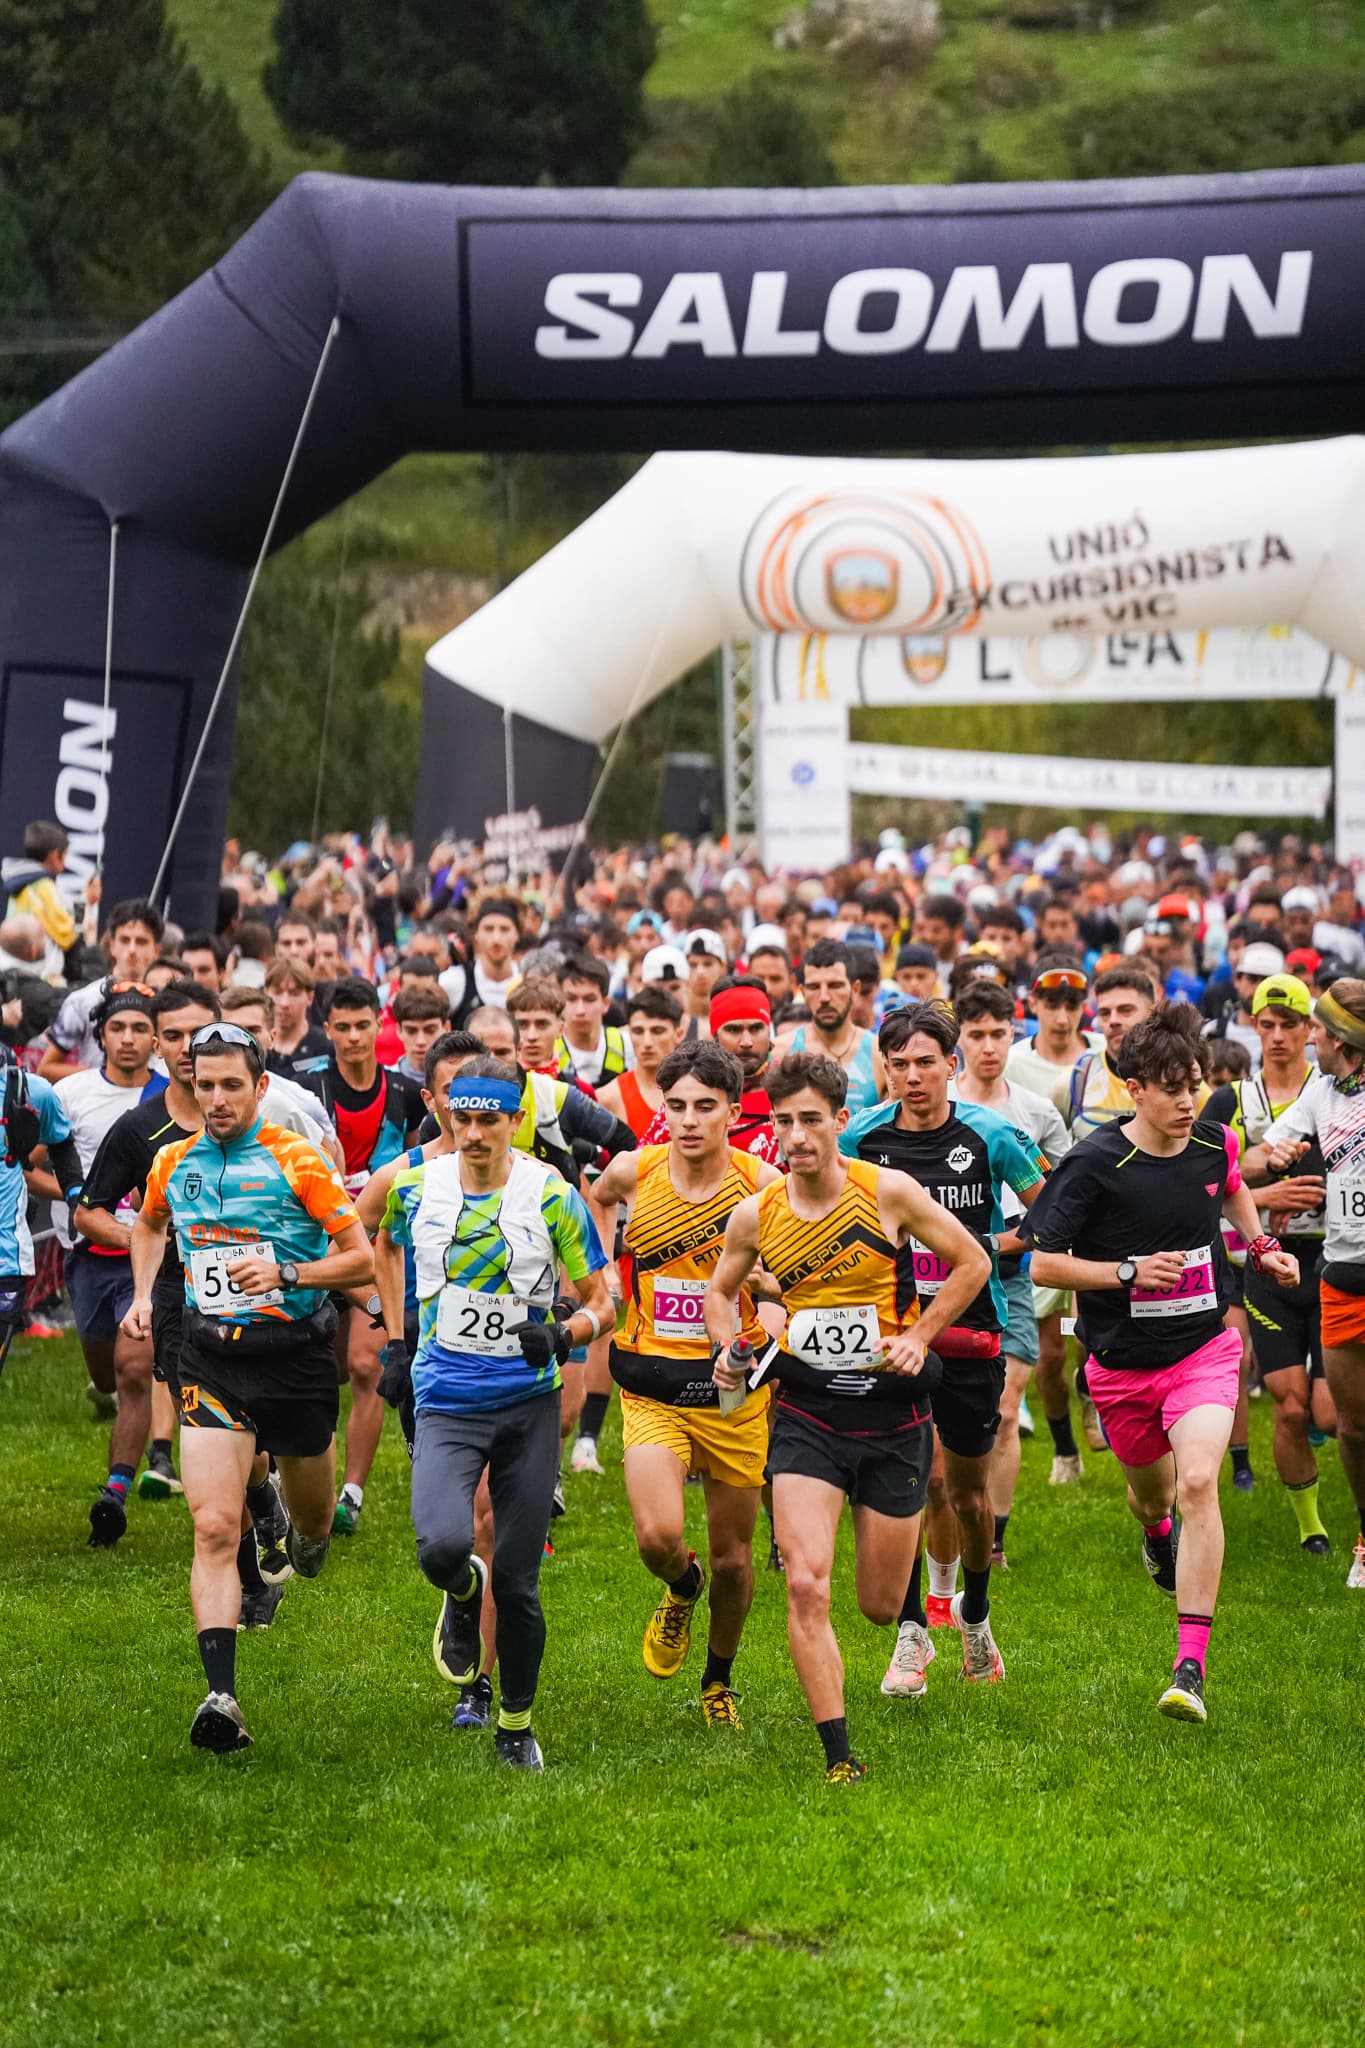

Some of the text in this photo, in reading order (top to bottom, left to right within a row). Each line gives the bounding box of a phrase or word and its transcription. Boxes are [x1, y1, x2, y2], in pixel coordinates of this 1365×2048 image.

[535, 250, 1314, 360] SALOMON
[1049, 510, 1149, 563] UNIÓ
[947, 531, 1295, 614] EXCURSIONISTA
[1103, 592, 1177, 623] VIC
[937, 1182, 985, 1209] TRAIL
[658, 1224, 719, 1262] LA SPO
[785, 1240, 843, 1285] LA SPO
[457, 1307, 505, 1341] 28
[801, 1324, 871, 1355] 432
